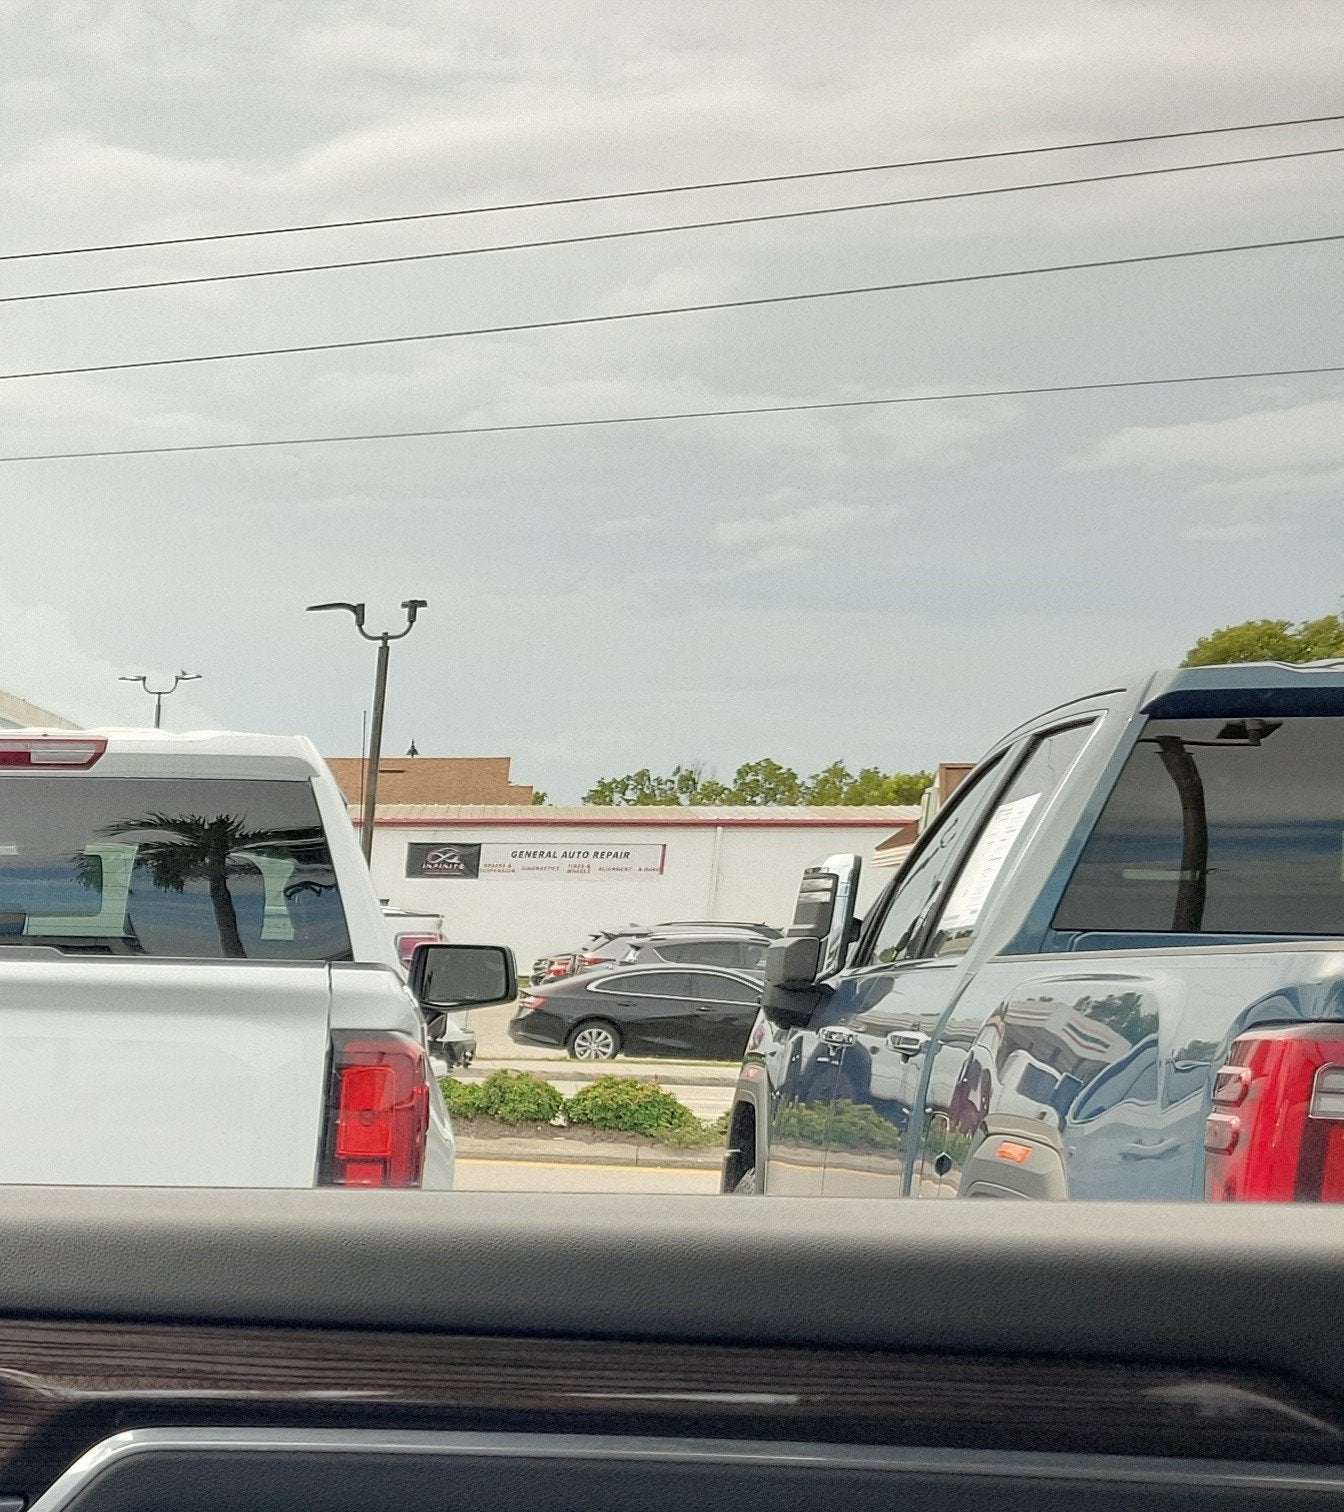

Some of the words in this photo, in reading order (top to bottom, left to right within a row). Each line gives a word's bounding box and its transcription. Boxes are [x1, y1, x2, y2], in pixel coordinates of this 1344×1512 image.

[511, 850, 558, 859] GENERAL
[561, 851, 590, 859] AUTO
[592, 851, 631, 860] REPAIR
